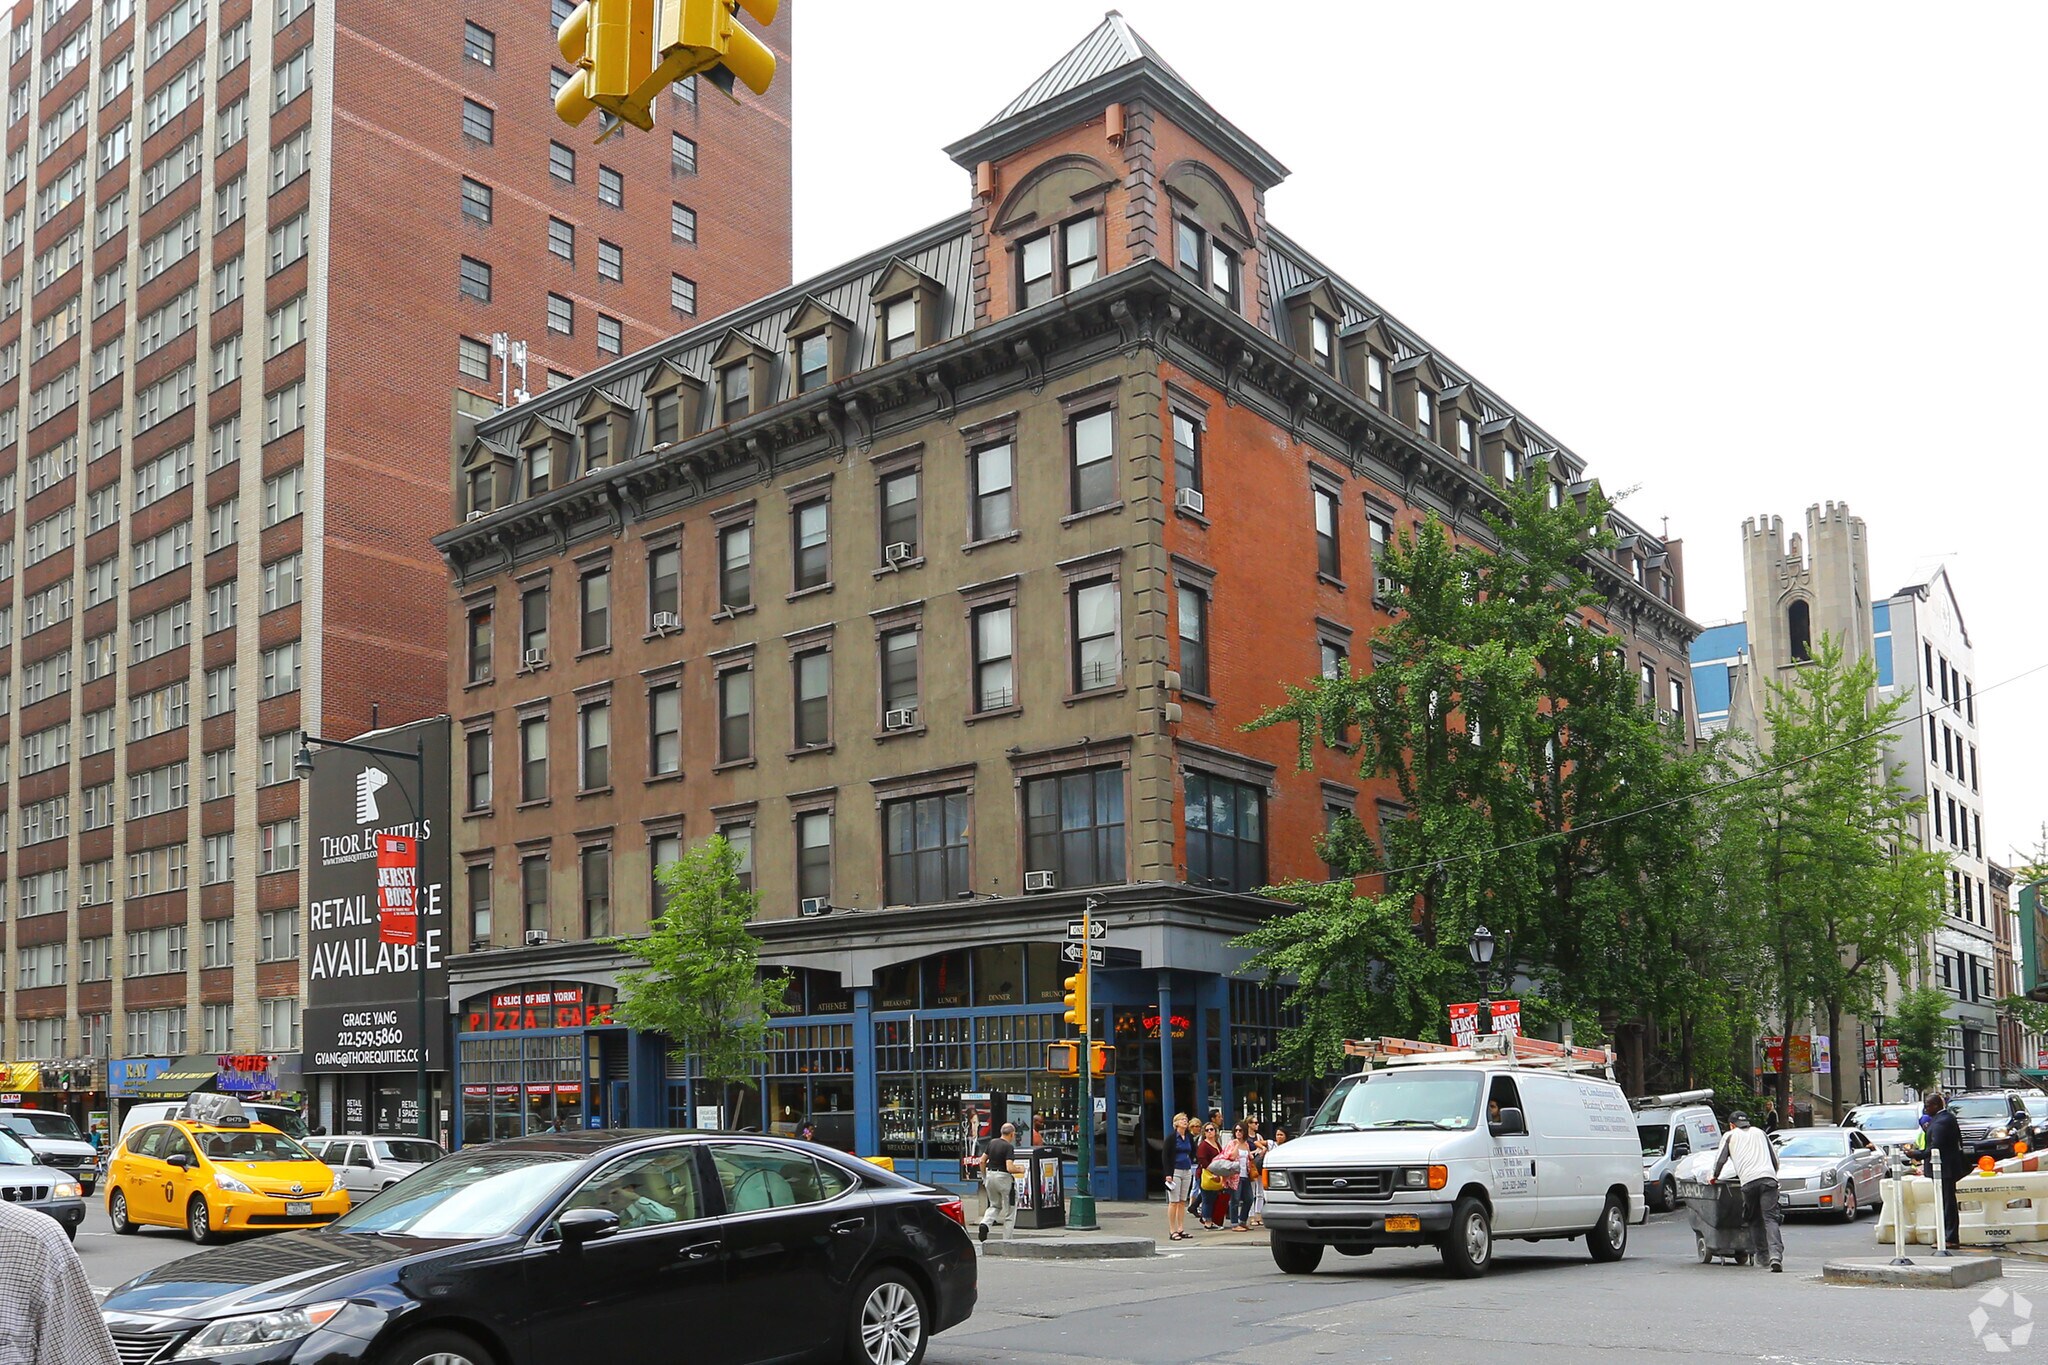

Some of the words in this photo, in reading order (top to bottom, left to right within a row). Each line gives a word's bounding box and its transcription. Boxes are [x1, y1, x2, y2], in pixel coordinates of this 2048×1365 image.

[320, 834, 360, 858] THOR
[378, 867, 416, 888] JERSEY
[384, 887, 413, 907] BOYS
[311, 894, 372, 931] RETAIL
[496, 997, 502, 1006] A
[525, 994, 535, 1004] OF
[554, 991, 576, 1002] YORK!
[342, 1012, 372, 1026] GRACE
[373, 1010, 397, 1025] YANG
[469, 1009, 538, 1032] PIZZA
[1450, 1014, 1478, 1034] JERSEY
[1492, 1012, 1520, 1031] JERSEY
[338, 1027, 403, 1048] 212.529.5860
[126, 1063, 148, 1078] RAY
[234, 1055, 268, 1072] GIFTS
[346, 1108, 362, 1116] SPACE
[402, 1109, 418, 1117] SPACE
[1096, 1100, 1104, 1108] A
